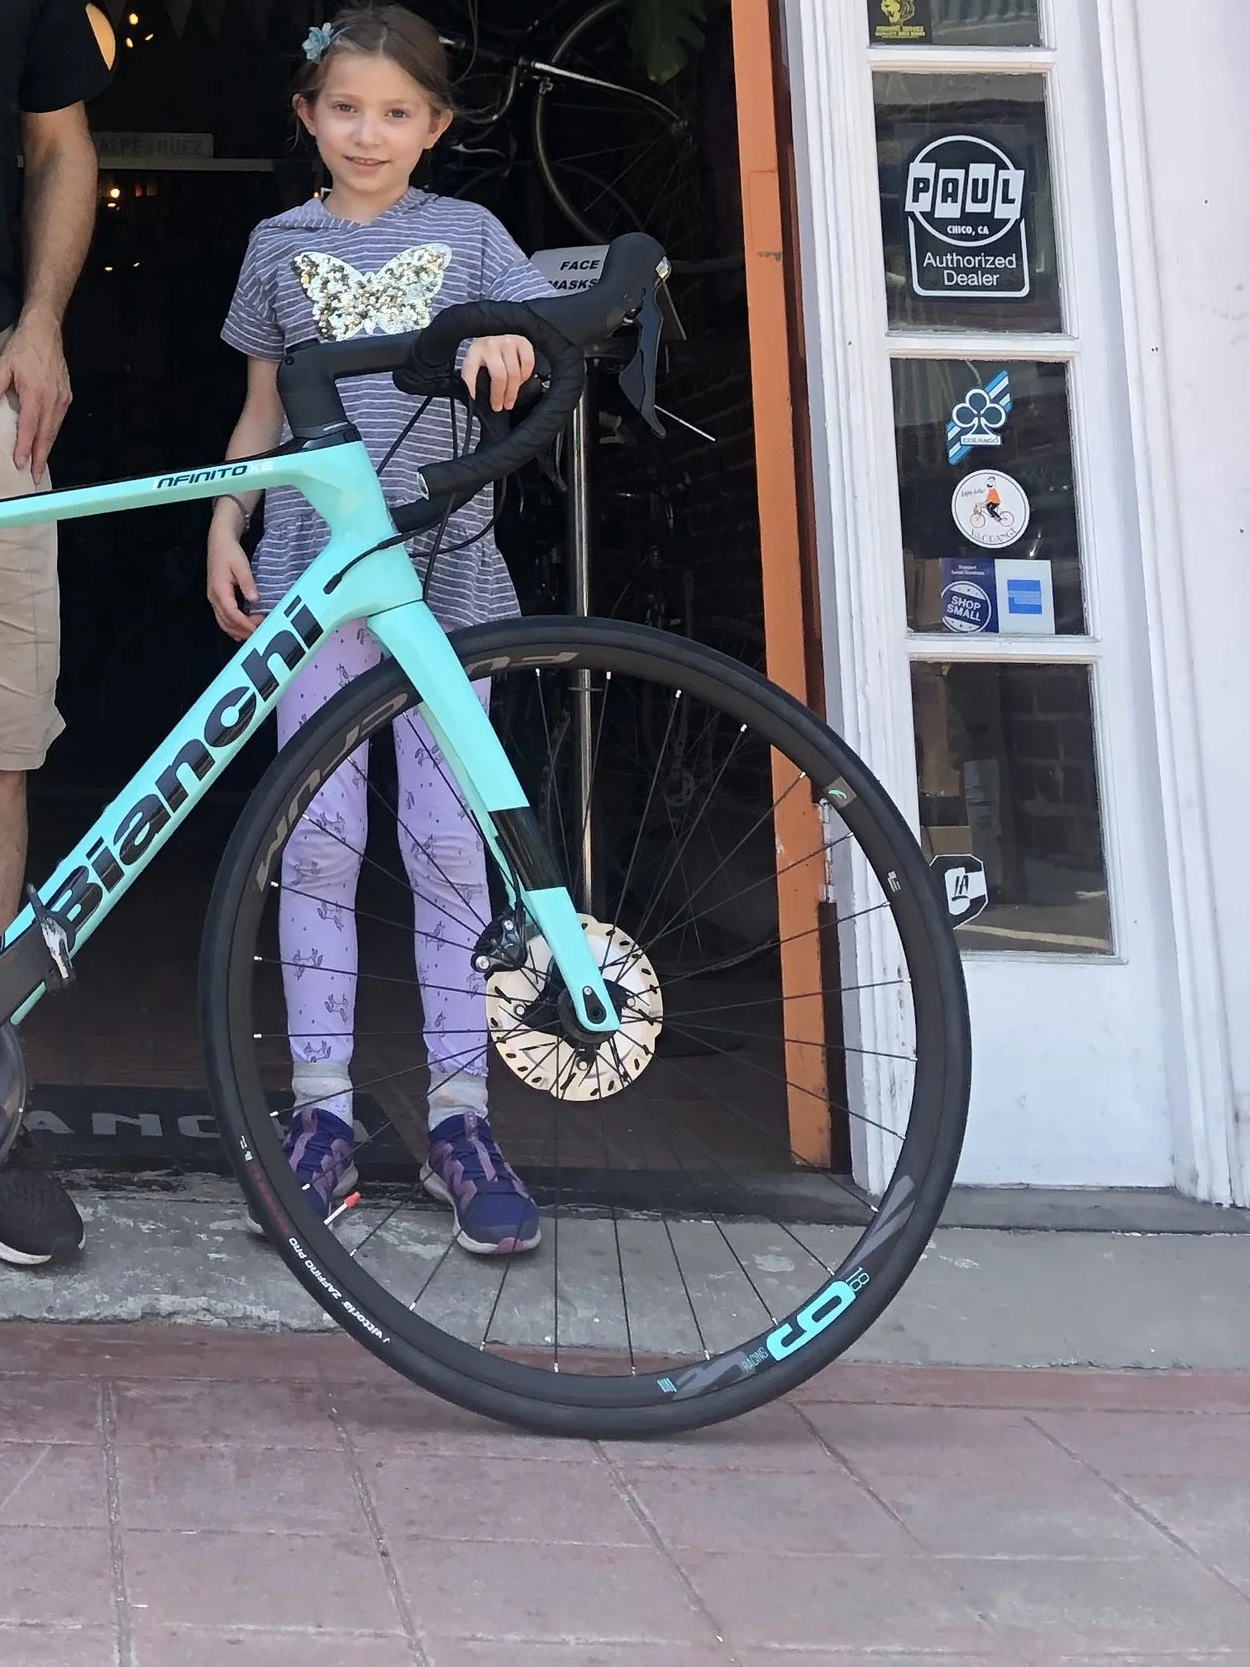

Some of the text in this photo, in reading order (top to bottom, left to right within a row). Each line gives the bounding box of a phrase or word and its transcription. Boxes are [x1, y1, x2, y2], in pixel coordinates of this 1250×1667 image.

[912, 177, 1016, 204] PAUL
[947, 225, 989, 236] CHICO, CA
[560, 259, 600, 271] FACE
[923, 252, 1017, 268] Authorized
[944, 270, 1000, 286] Dealer
[951, 595, 981, 610] SHOP
[946, 604, 982, 622] SMALL
[50, 595, 324, 943] Bianchi
[288, 1237, 384, 1343] vittoria ZAFFIRO PRO
